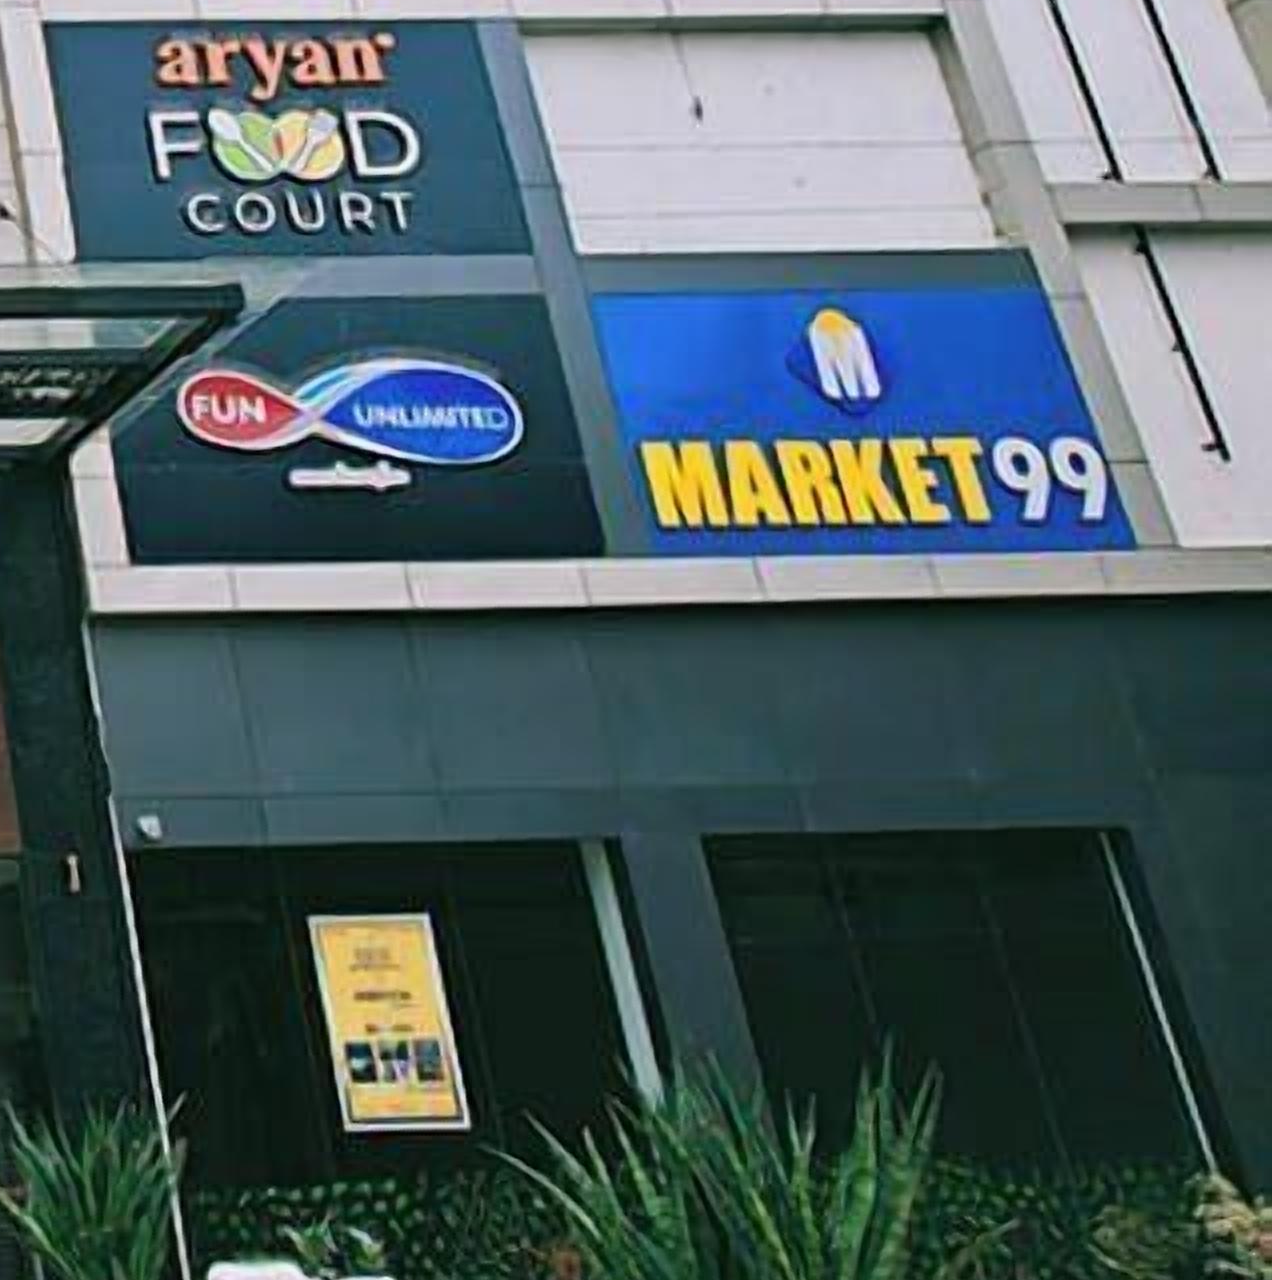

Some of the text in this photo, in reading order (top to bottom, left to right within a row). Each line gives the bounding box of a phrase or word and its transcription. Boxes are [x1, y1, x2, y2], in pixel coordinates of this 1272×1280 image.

[156, 32, 385, 102] aryan
[186, 192, 414, 234] COURT
[190, 394, 268, 424] FUN
